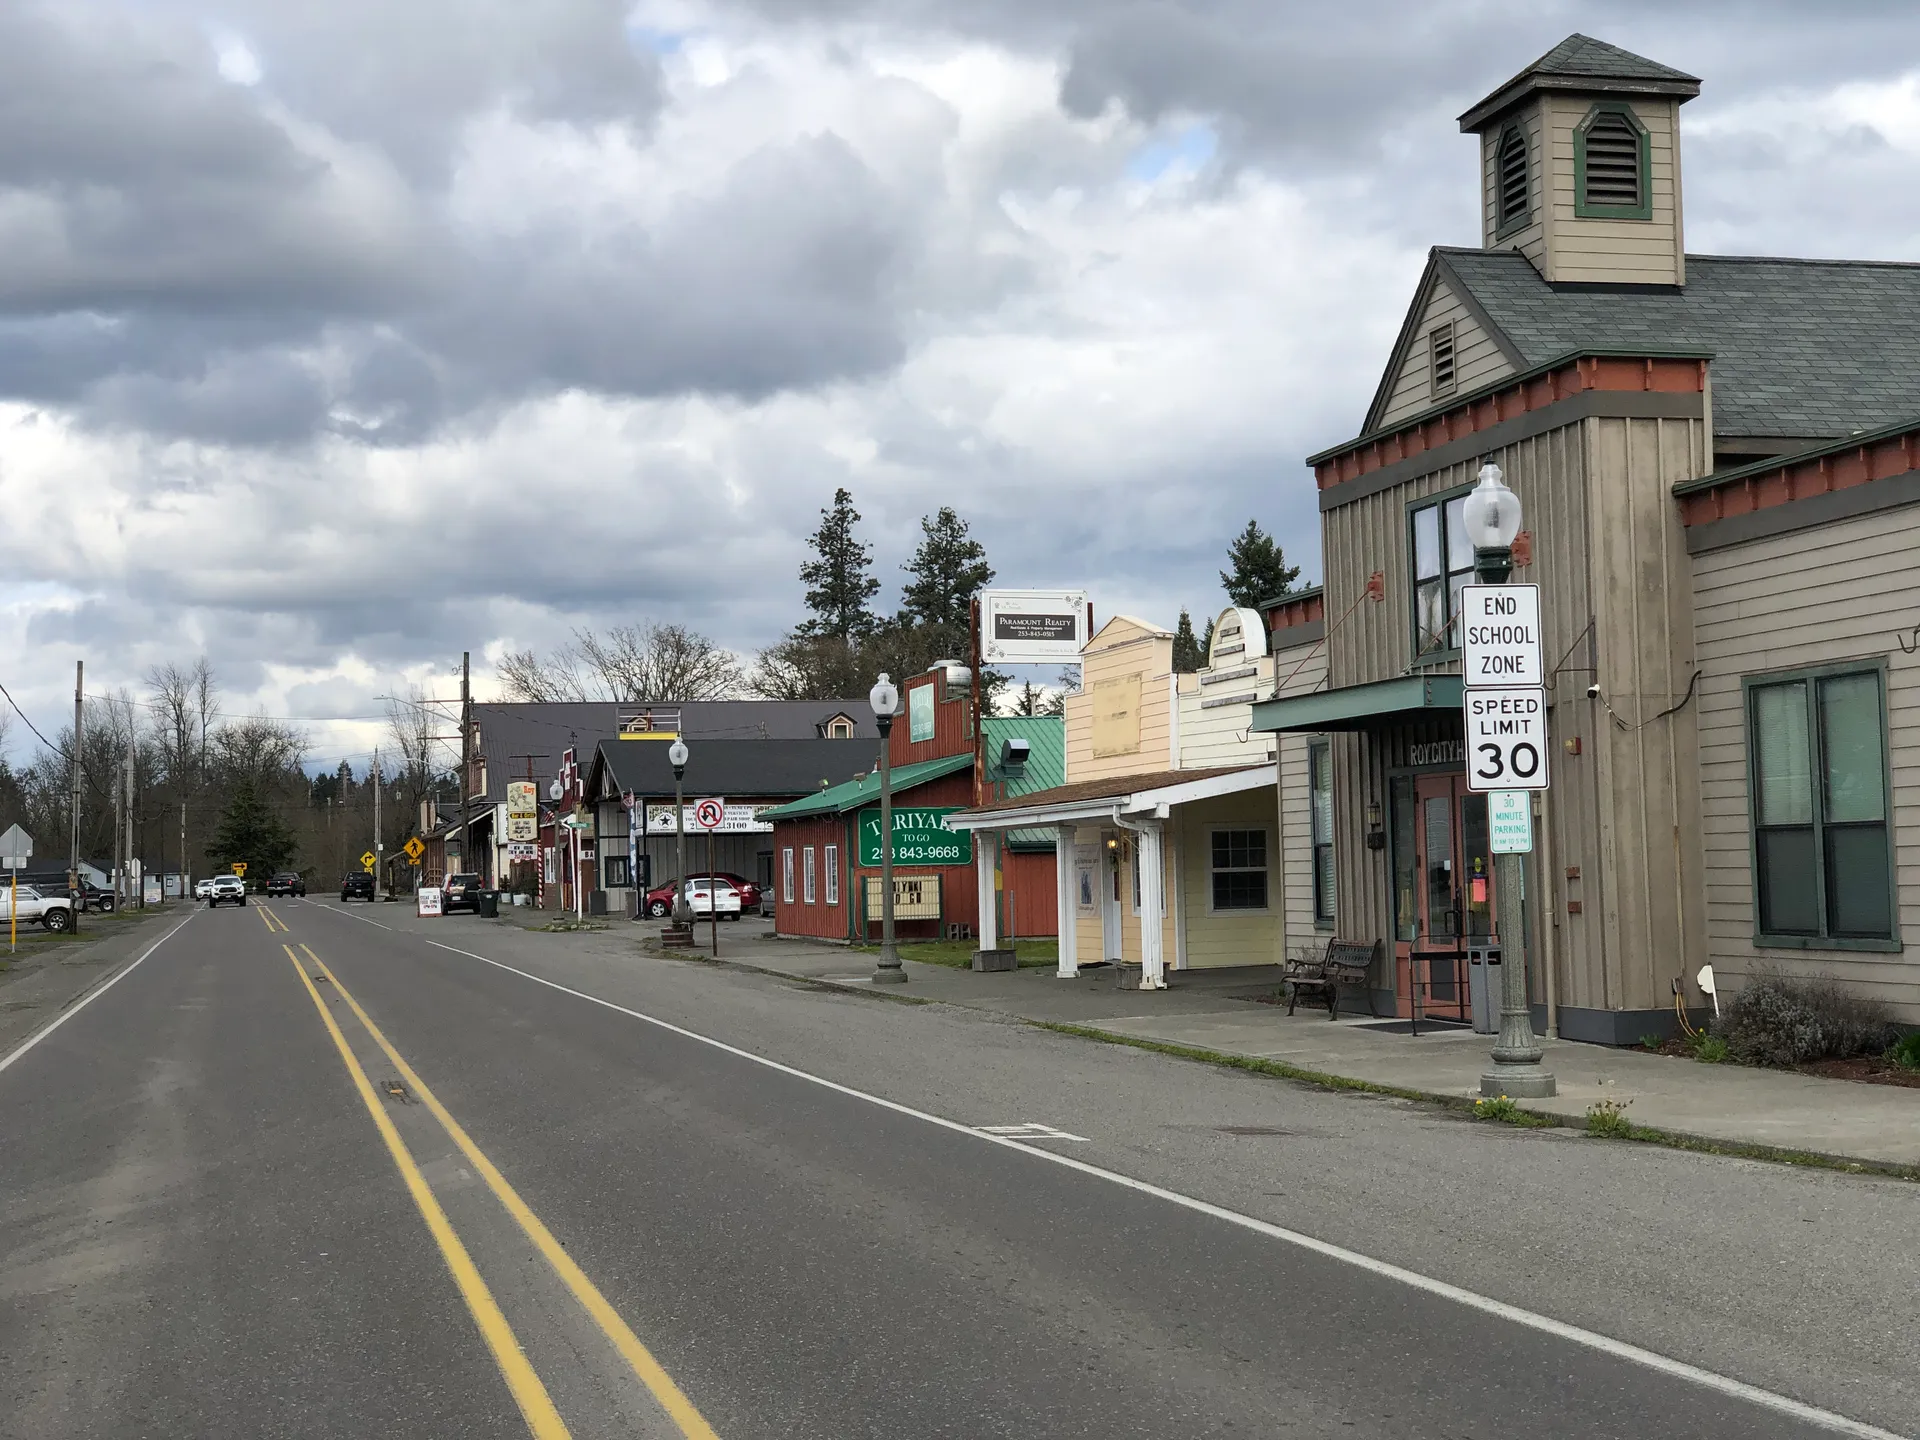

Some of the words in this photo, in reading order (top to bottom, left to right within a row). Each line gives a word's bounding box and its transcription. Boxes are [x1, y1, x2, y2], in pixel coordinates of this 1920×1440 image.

[1485, 597, 1517, 615] END
[999, 617, 1041, 626] PARAMOUNT
[1045, 617, 1071, 626] REALTY
[1469, 626, 1535, 645] SCHOOL
[1481, 655, 1525, 674] ZONE
[1472, 699, 1538, 715] SPEED
[1480, 719, 1531, 736] LIMIT
[1410, 743, 1429, 766] ROY
[1431, 740, 1455, 763] CITY
[1476, 742, 1539, 779] 30
[1503, 798, 1515, 808] 30
[1496, 811, 1524, 821] MINUTE
[902, 833, 915, 842] TO
[916, 833, 930, 842] GO
[1494, 825, 1527, 834] PARKING
[899, 846, 960, 859] 843-9668
